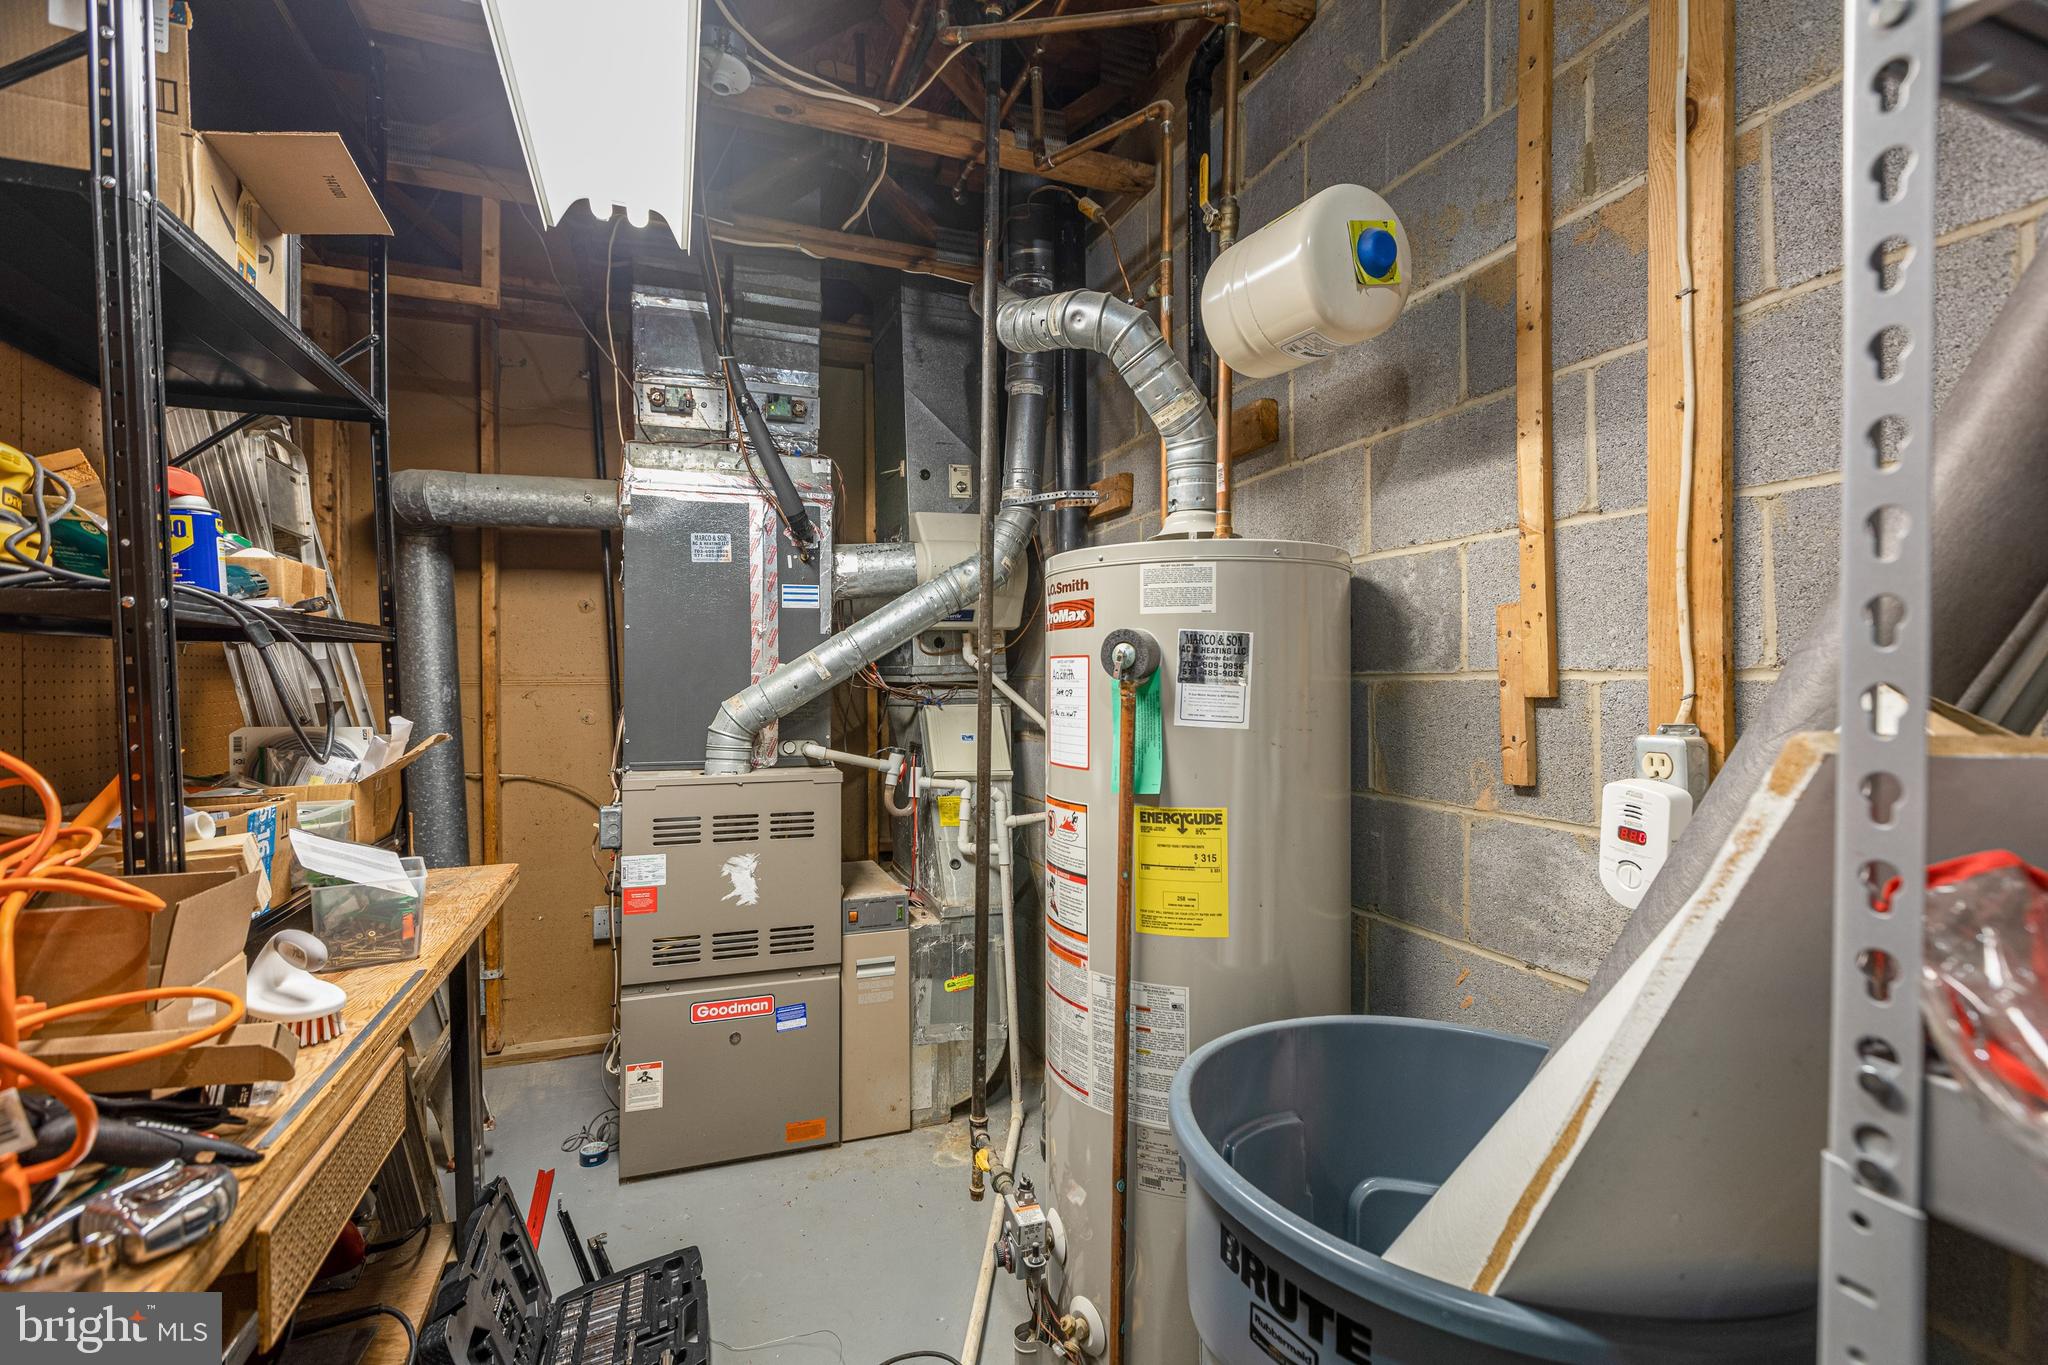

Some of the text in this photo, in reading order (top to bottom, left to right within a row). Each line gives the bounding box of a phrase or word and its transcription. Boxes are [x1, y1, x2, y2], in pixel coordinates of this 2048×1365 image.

[1185, 633, 1243, 647] MARCO & SON
[1181, 645, 1191, 653] AC
[1200, 646, 1232, 655] HEATING
[1233, 647, 1246, 656] LLC
[1201, 853, 1217, 862] 315
[697, 1001, 769, 1018] Goodman
[1221, 1223, 1373, 1365] BRUTE
[1254, 1313, 1312, 1364] Rubbermaid
